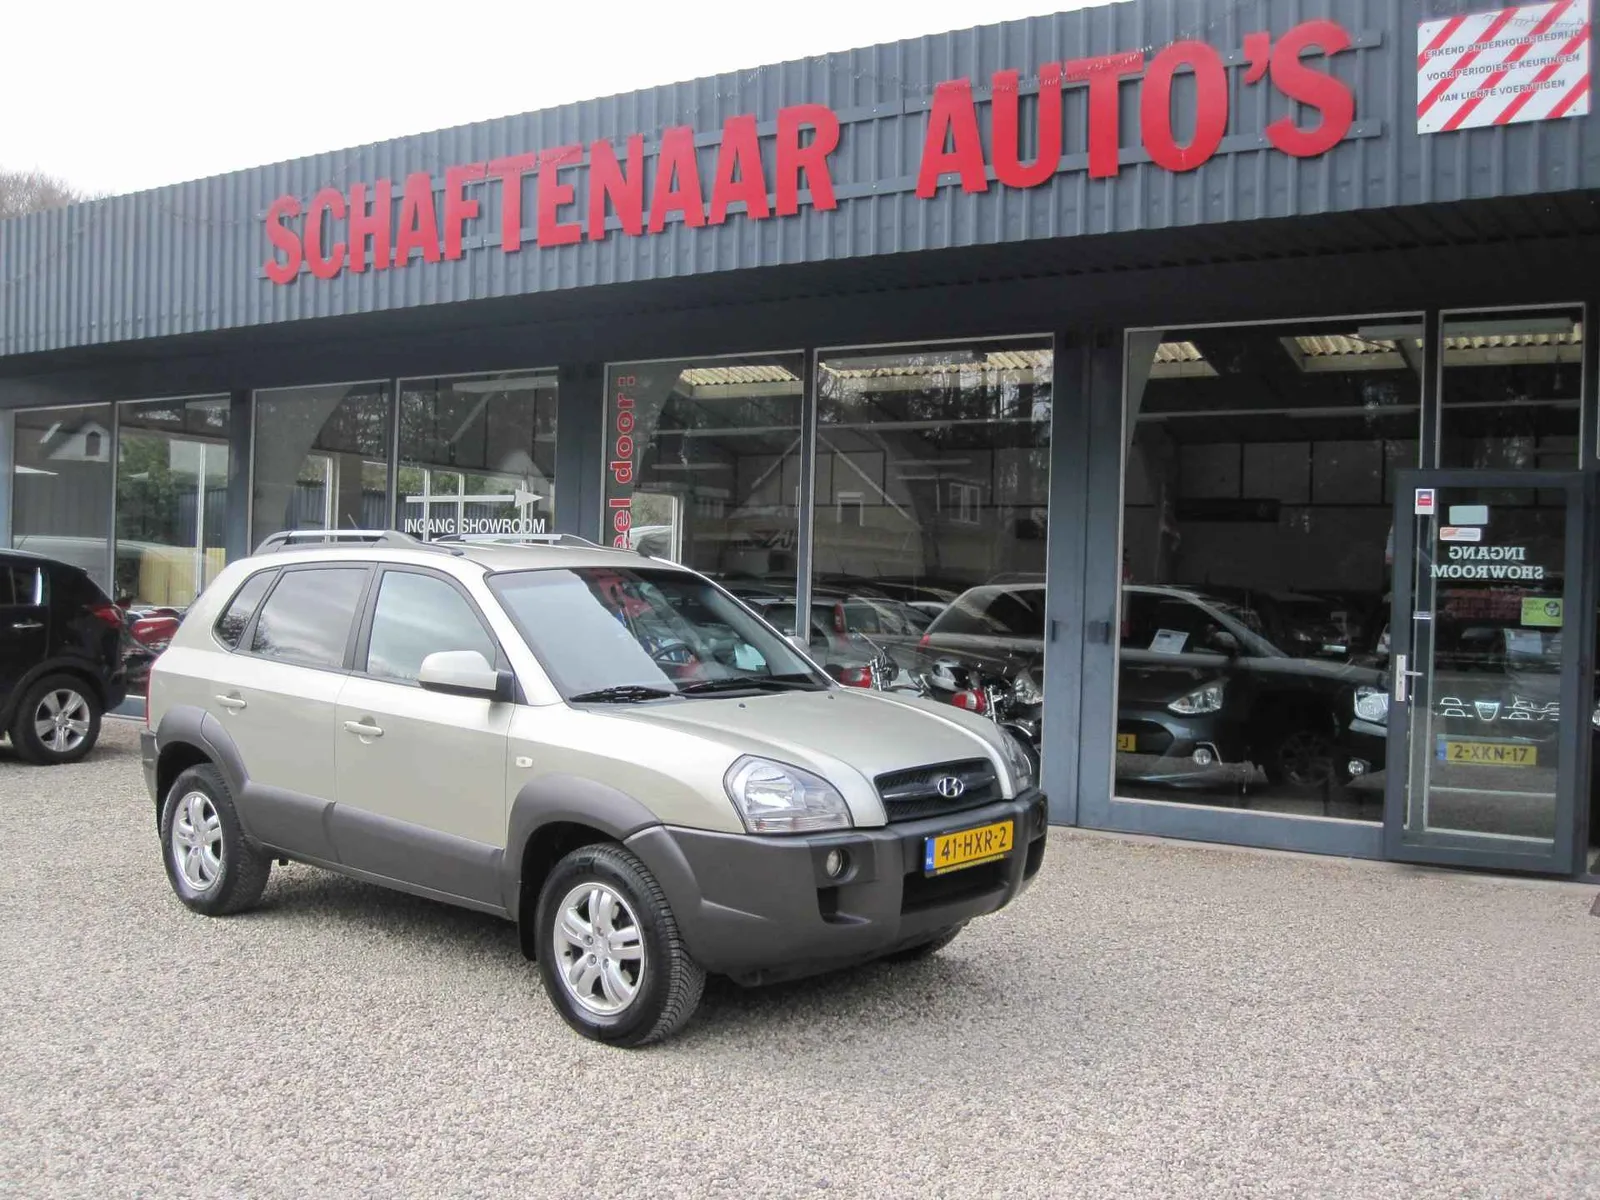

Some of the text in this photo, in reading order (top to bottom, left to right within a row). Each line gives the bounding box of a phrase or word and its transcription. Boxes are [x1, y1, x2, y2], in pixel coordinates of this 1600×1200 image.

[1425, 45, 1465, 59] ERKEND
[1426, 54, 1580, 81] VOOR PERIODIEKE KEURINGEN
[1438, 79, 1566, 103] VAN LICHTE VOERTUIGEN
[264, 18, 1355, 285] SCHAFTENAAR AUTO'S
[404, 518, 546, 534] INGANG SHOWROOM
[1453, 744, 1529, 762] 2-XKN-17
[941, 826, 1007, 861] 41-HXR-2
